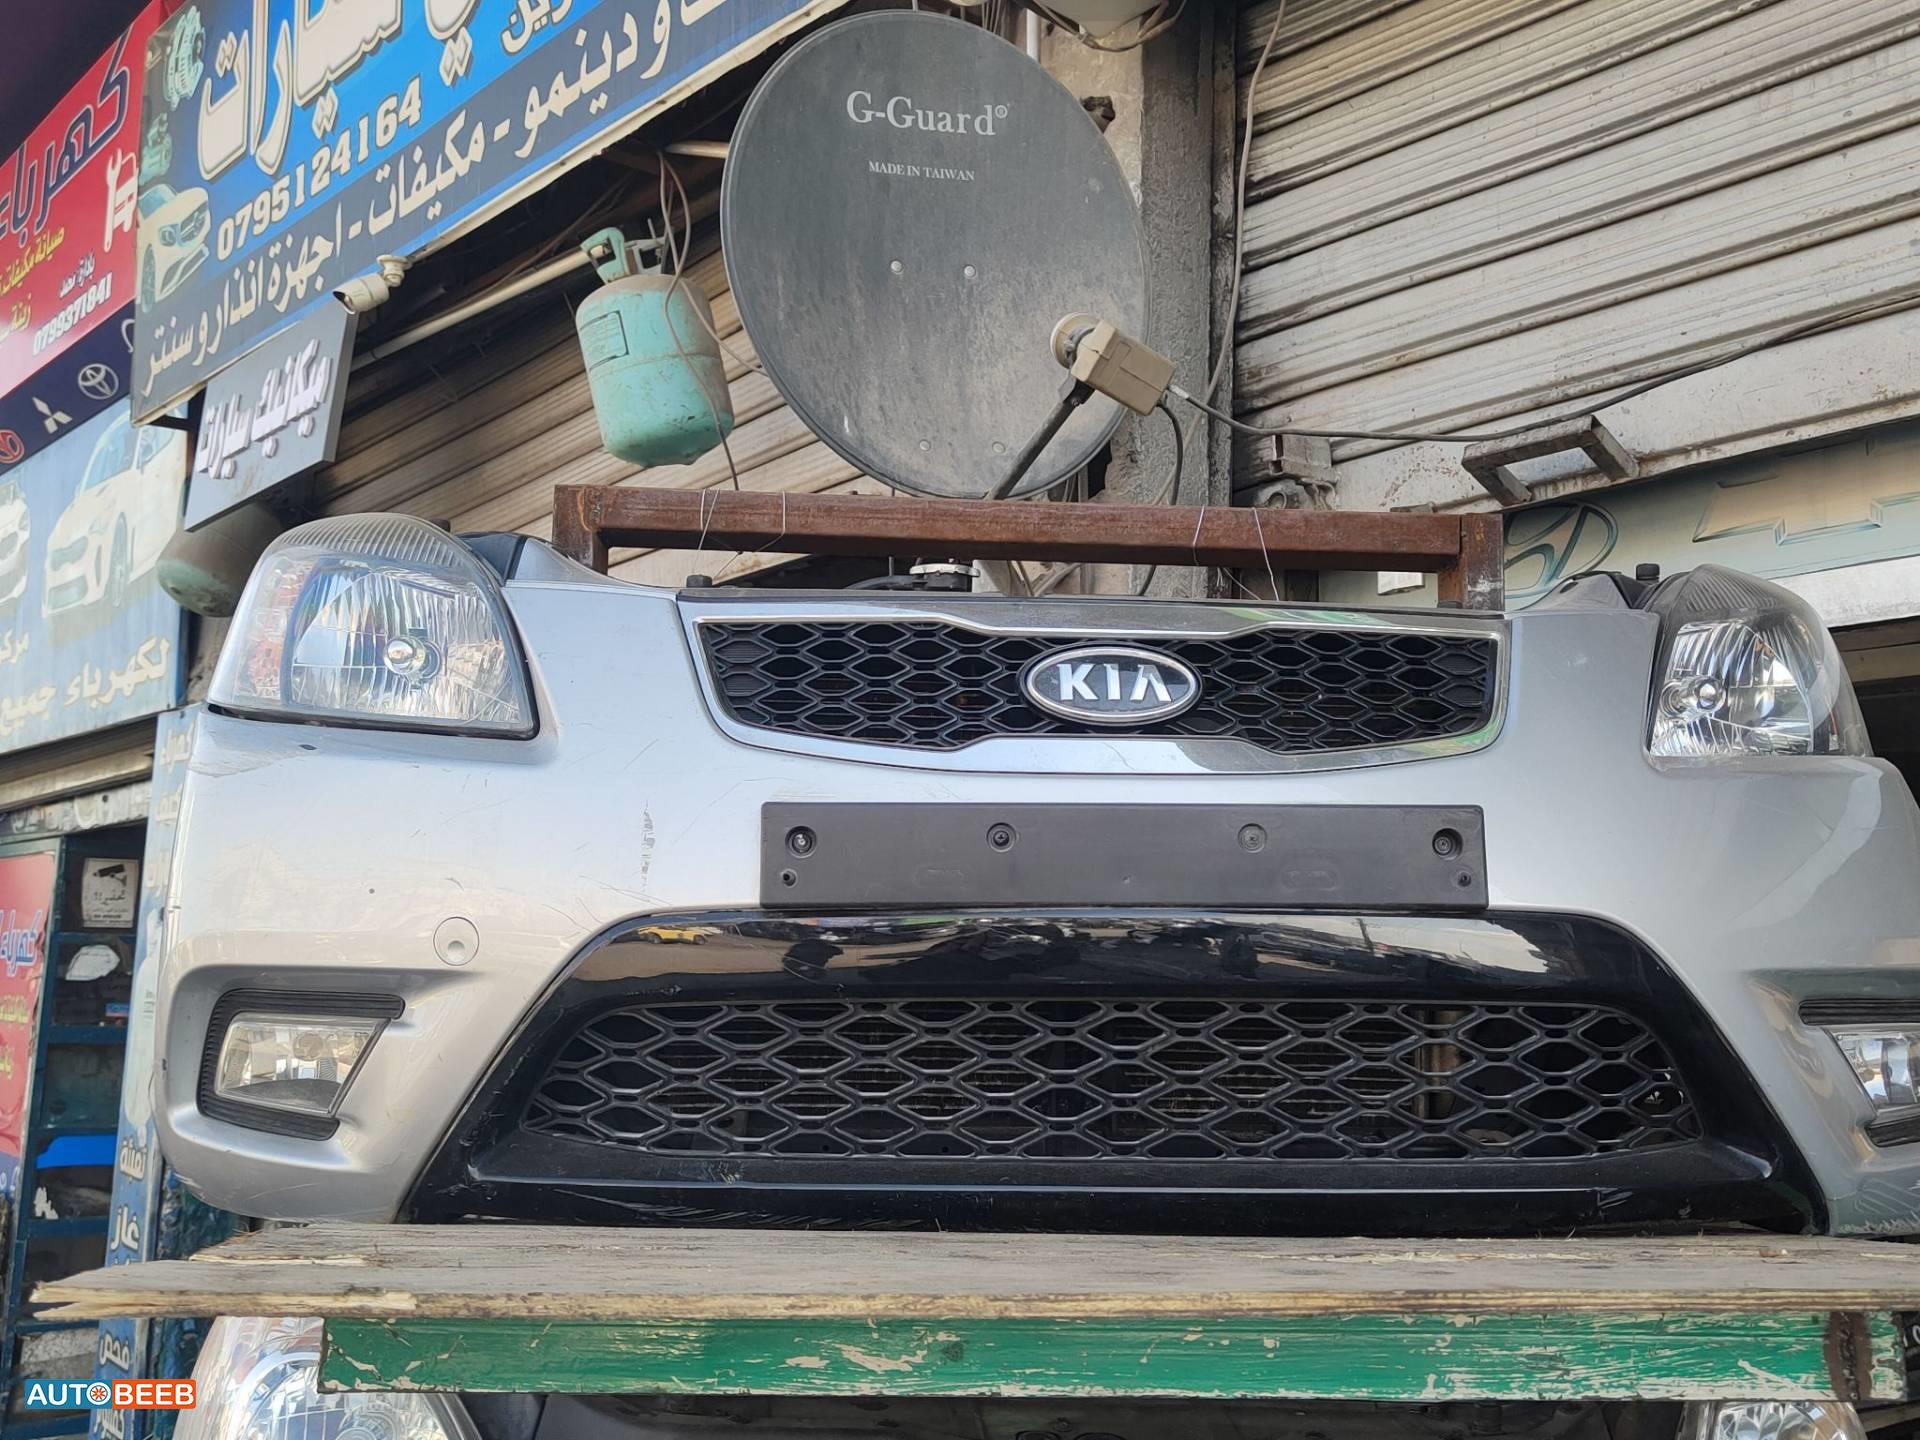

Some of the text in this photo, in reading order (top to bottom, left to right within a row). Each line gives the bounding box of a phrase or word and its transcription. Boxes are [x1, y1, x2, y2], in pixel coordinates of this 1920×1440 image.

[217, 76, 422, 261] 0795124164
[368, 110, 485, 236] مكيفات
[868, 160, 976, 181] MADE IN TAIWAN
[1056, 663, 1172, 702] KIA
[110, 1204, 140, 1251] غاز
[99, 1331, 131, 1371] فحص
